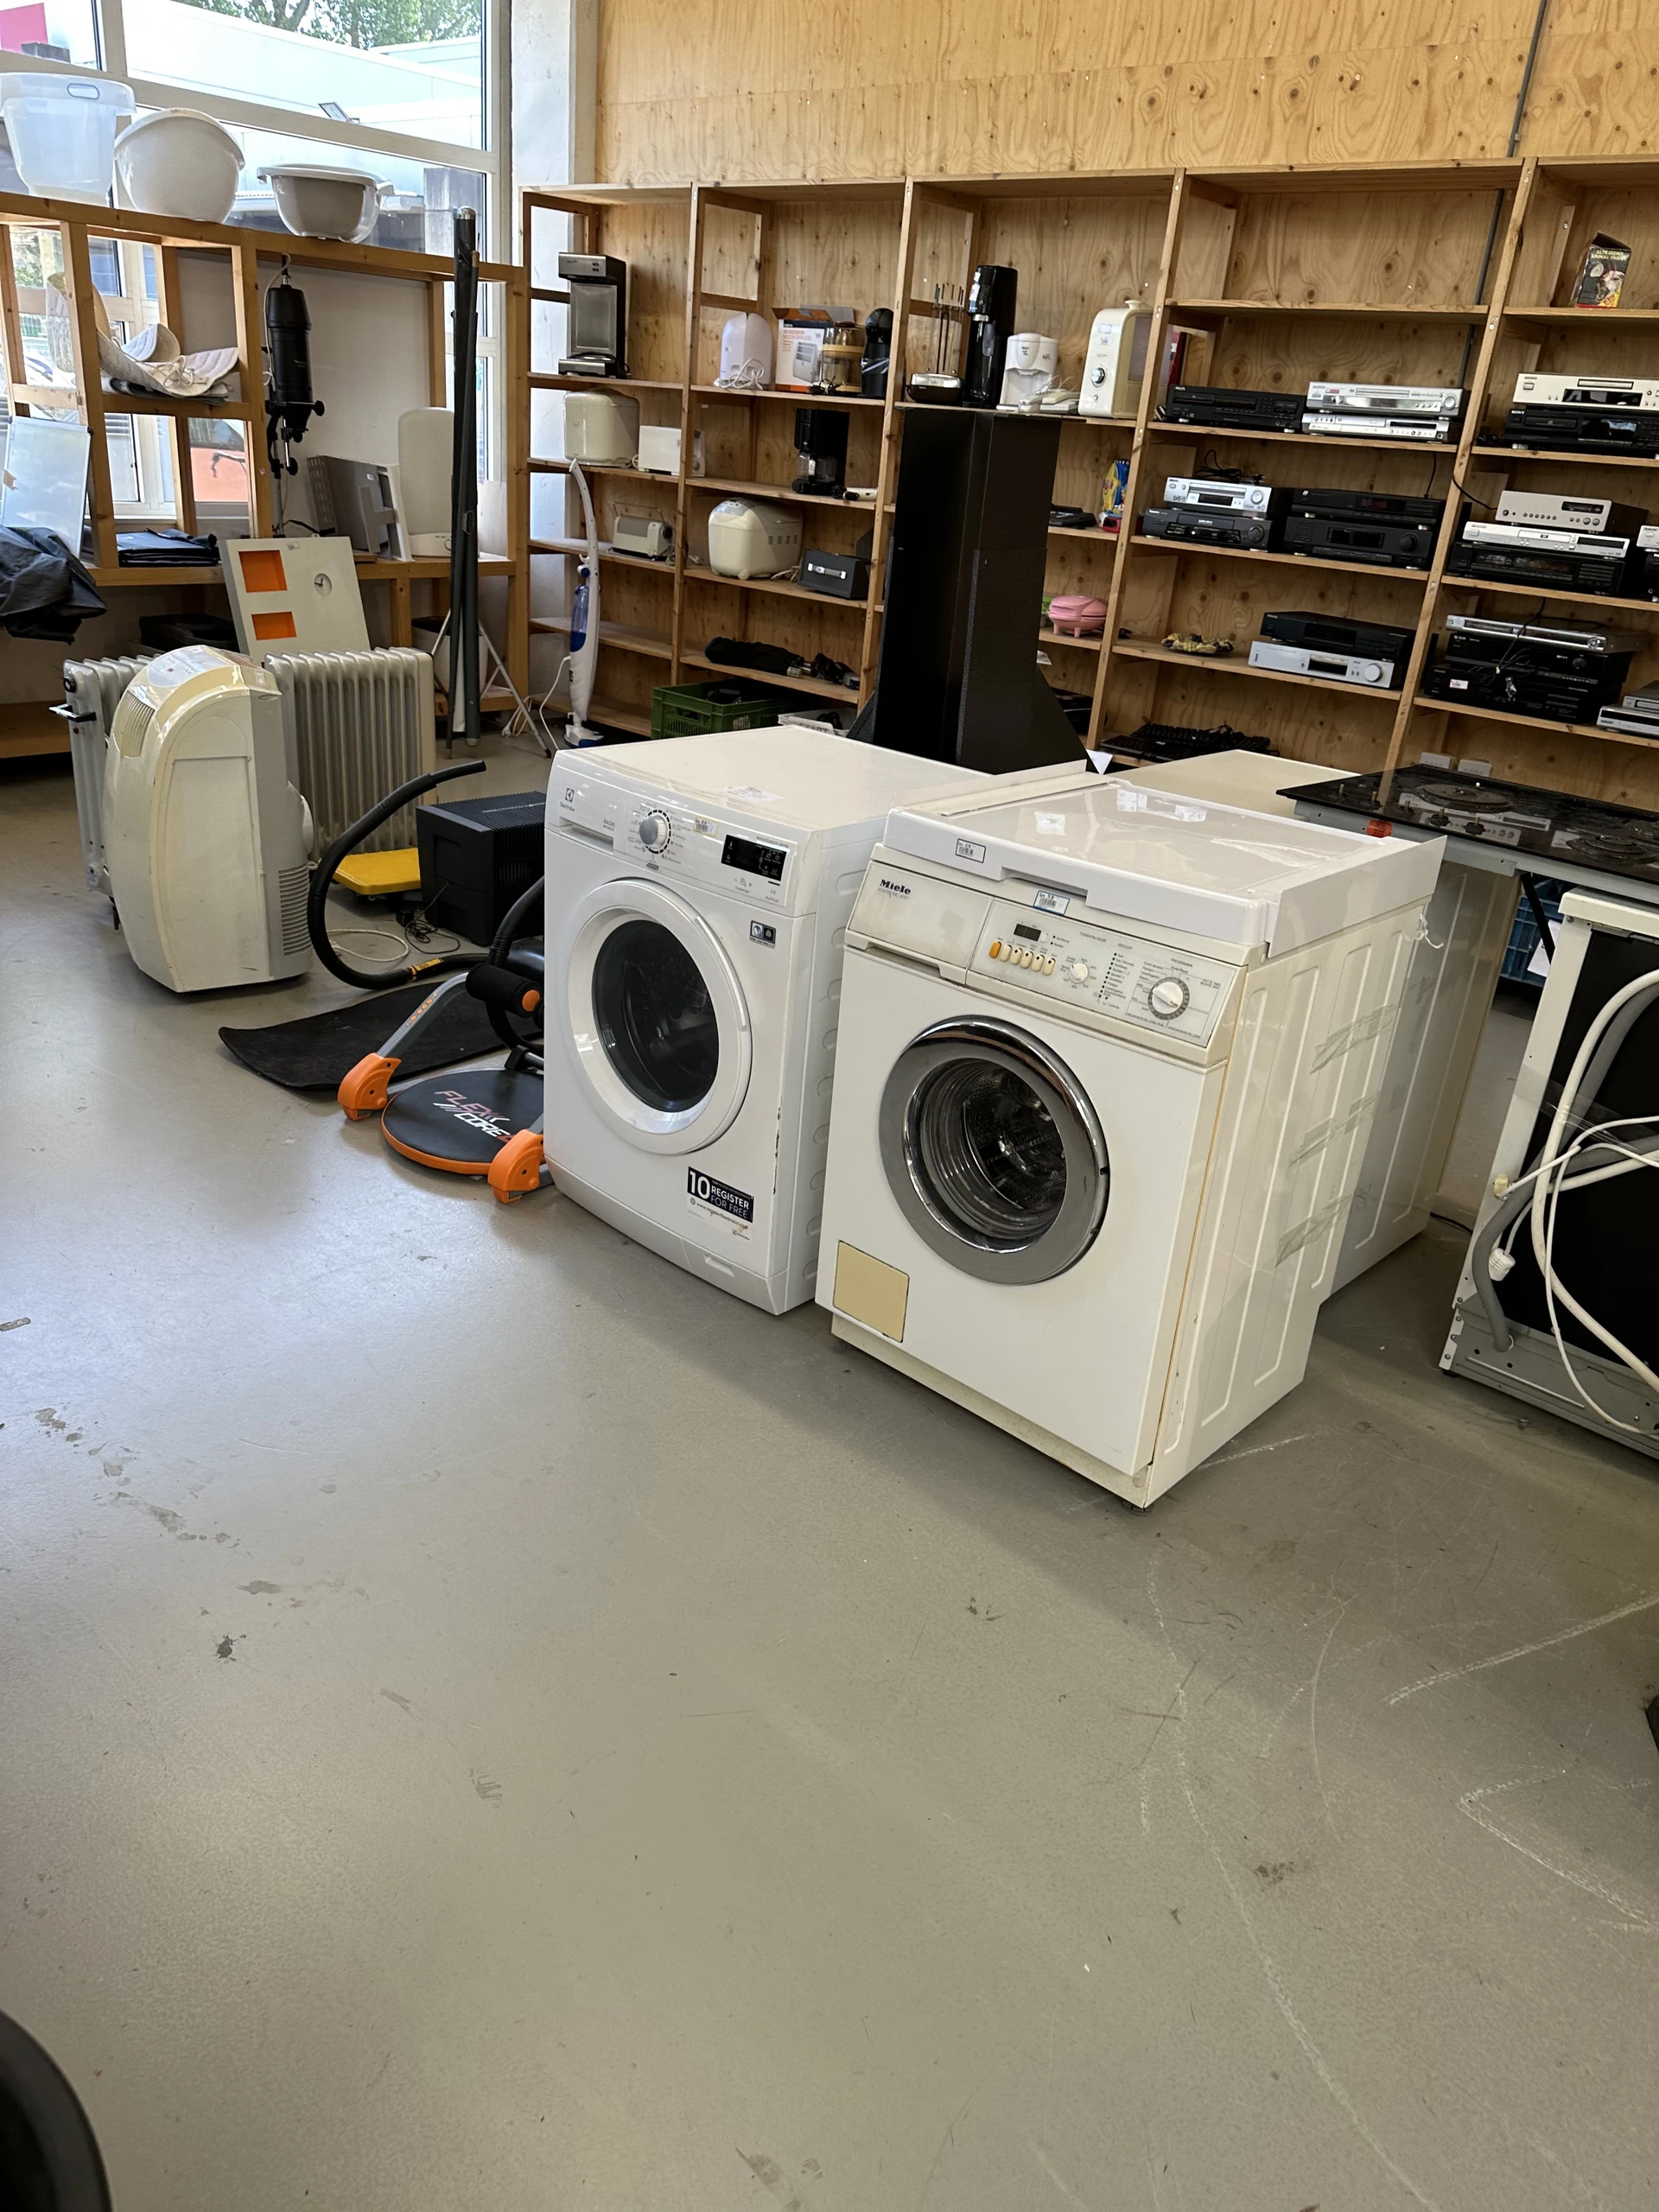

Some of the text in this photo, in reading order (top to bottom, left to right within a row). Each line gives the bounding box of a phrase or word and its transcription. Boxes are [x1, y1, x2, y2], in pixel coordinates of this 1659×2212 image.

[880, 879, 912, 895] Miele
[690, 1170, 711, 1199] 10
[710, 1195, 748, 1219] FOR FREE
[711, 1185, 749, 1211] REGISTER
